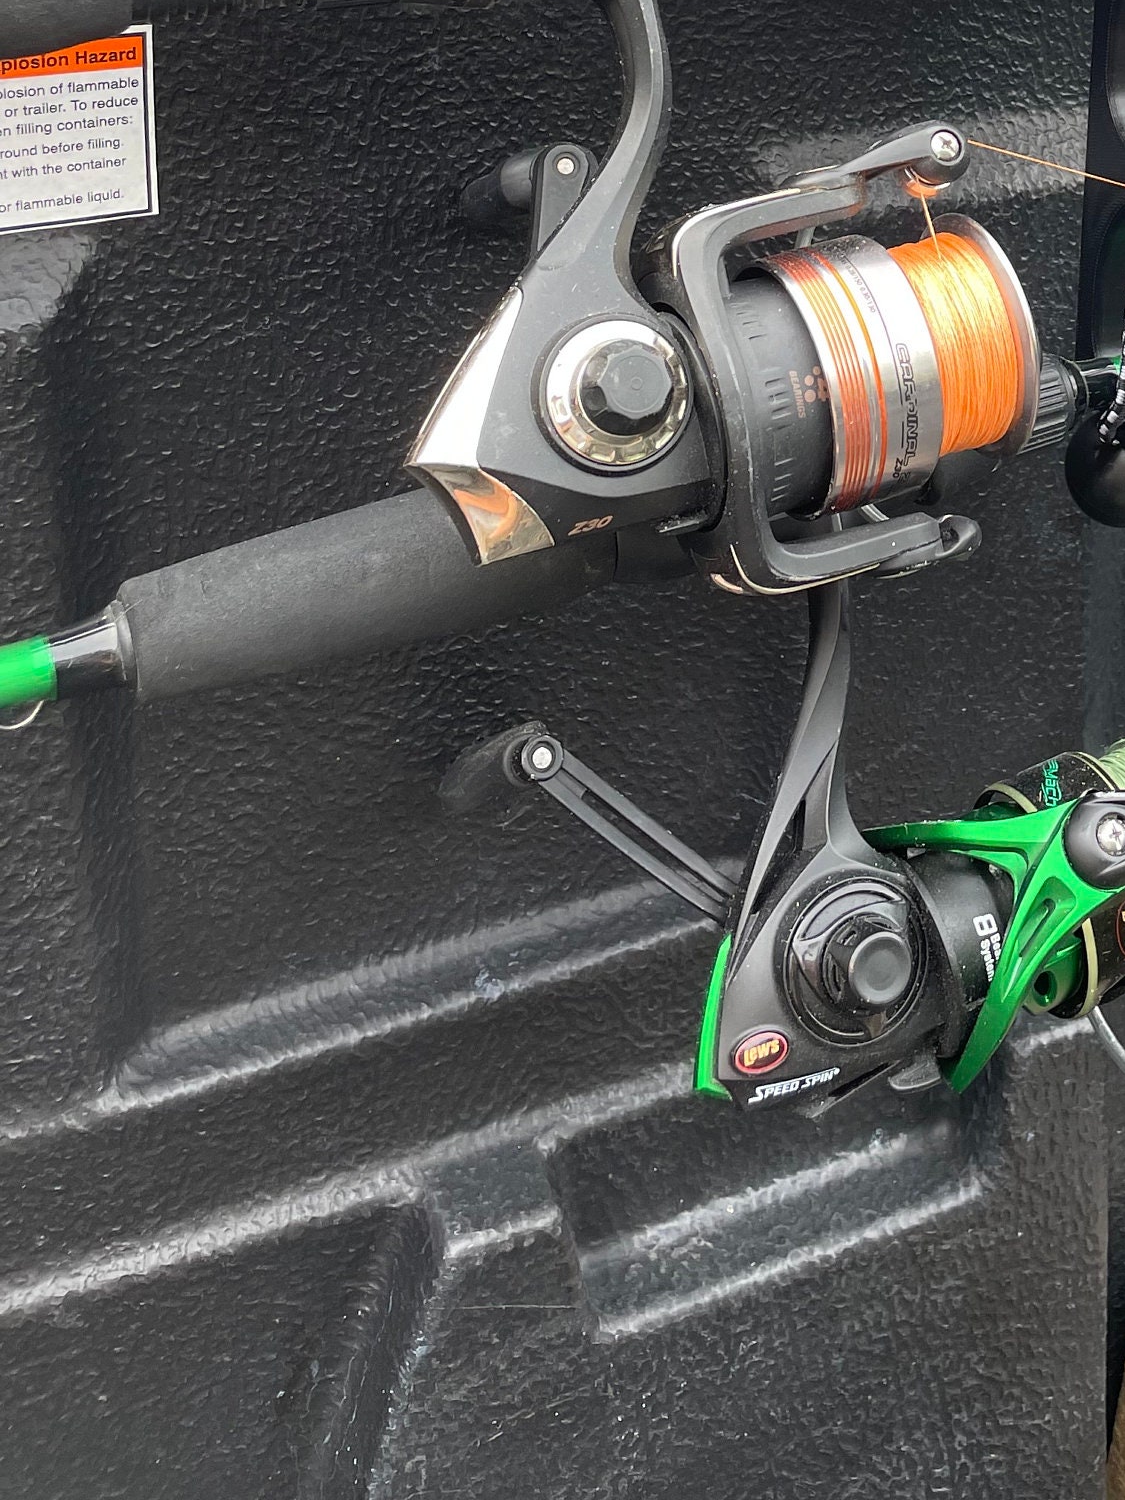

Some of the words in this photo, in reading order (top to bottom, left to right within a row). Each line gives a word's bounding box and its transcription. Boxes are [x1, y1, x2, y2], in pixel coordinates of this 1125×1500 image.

[0, 53, 69, 75] plosion
[75, 47, 137, 65] Hazard
[50, 83, 63, 95] of
[68, 77, 139, 93] flammable
[4, 108, 18, 118] or
[23, 102, 66, 116] trailer.
[70, 100, 87, 111] To
[92, 97, 138, 109] reduce
[16, 123, 52, 135] filling
[57, 115, 133, 131] containers:
[42, 142, 83, 155] before
[87, 138, 124, 150] filling.
[12, 166, 38, 178] with
[41, 164, 62, 174] the
[66, 156, 126, 172] container
[16, 193, 83, 211] flammable
[87, 188, 124, 204] liquid.
[789, 370, 806, 419] BEARINGS
[567, 515, 614, 536] Z30
[972, 913, 998, 937] 8
[748, 1082, 800, 1105] SPEED
[801, 1068, 835, 1089] SPIN
